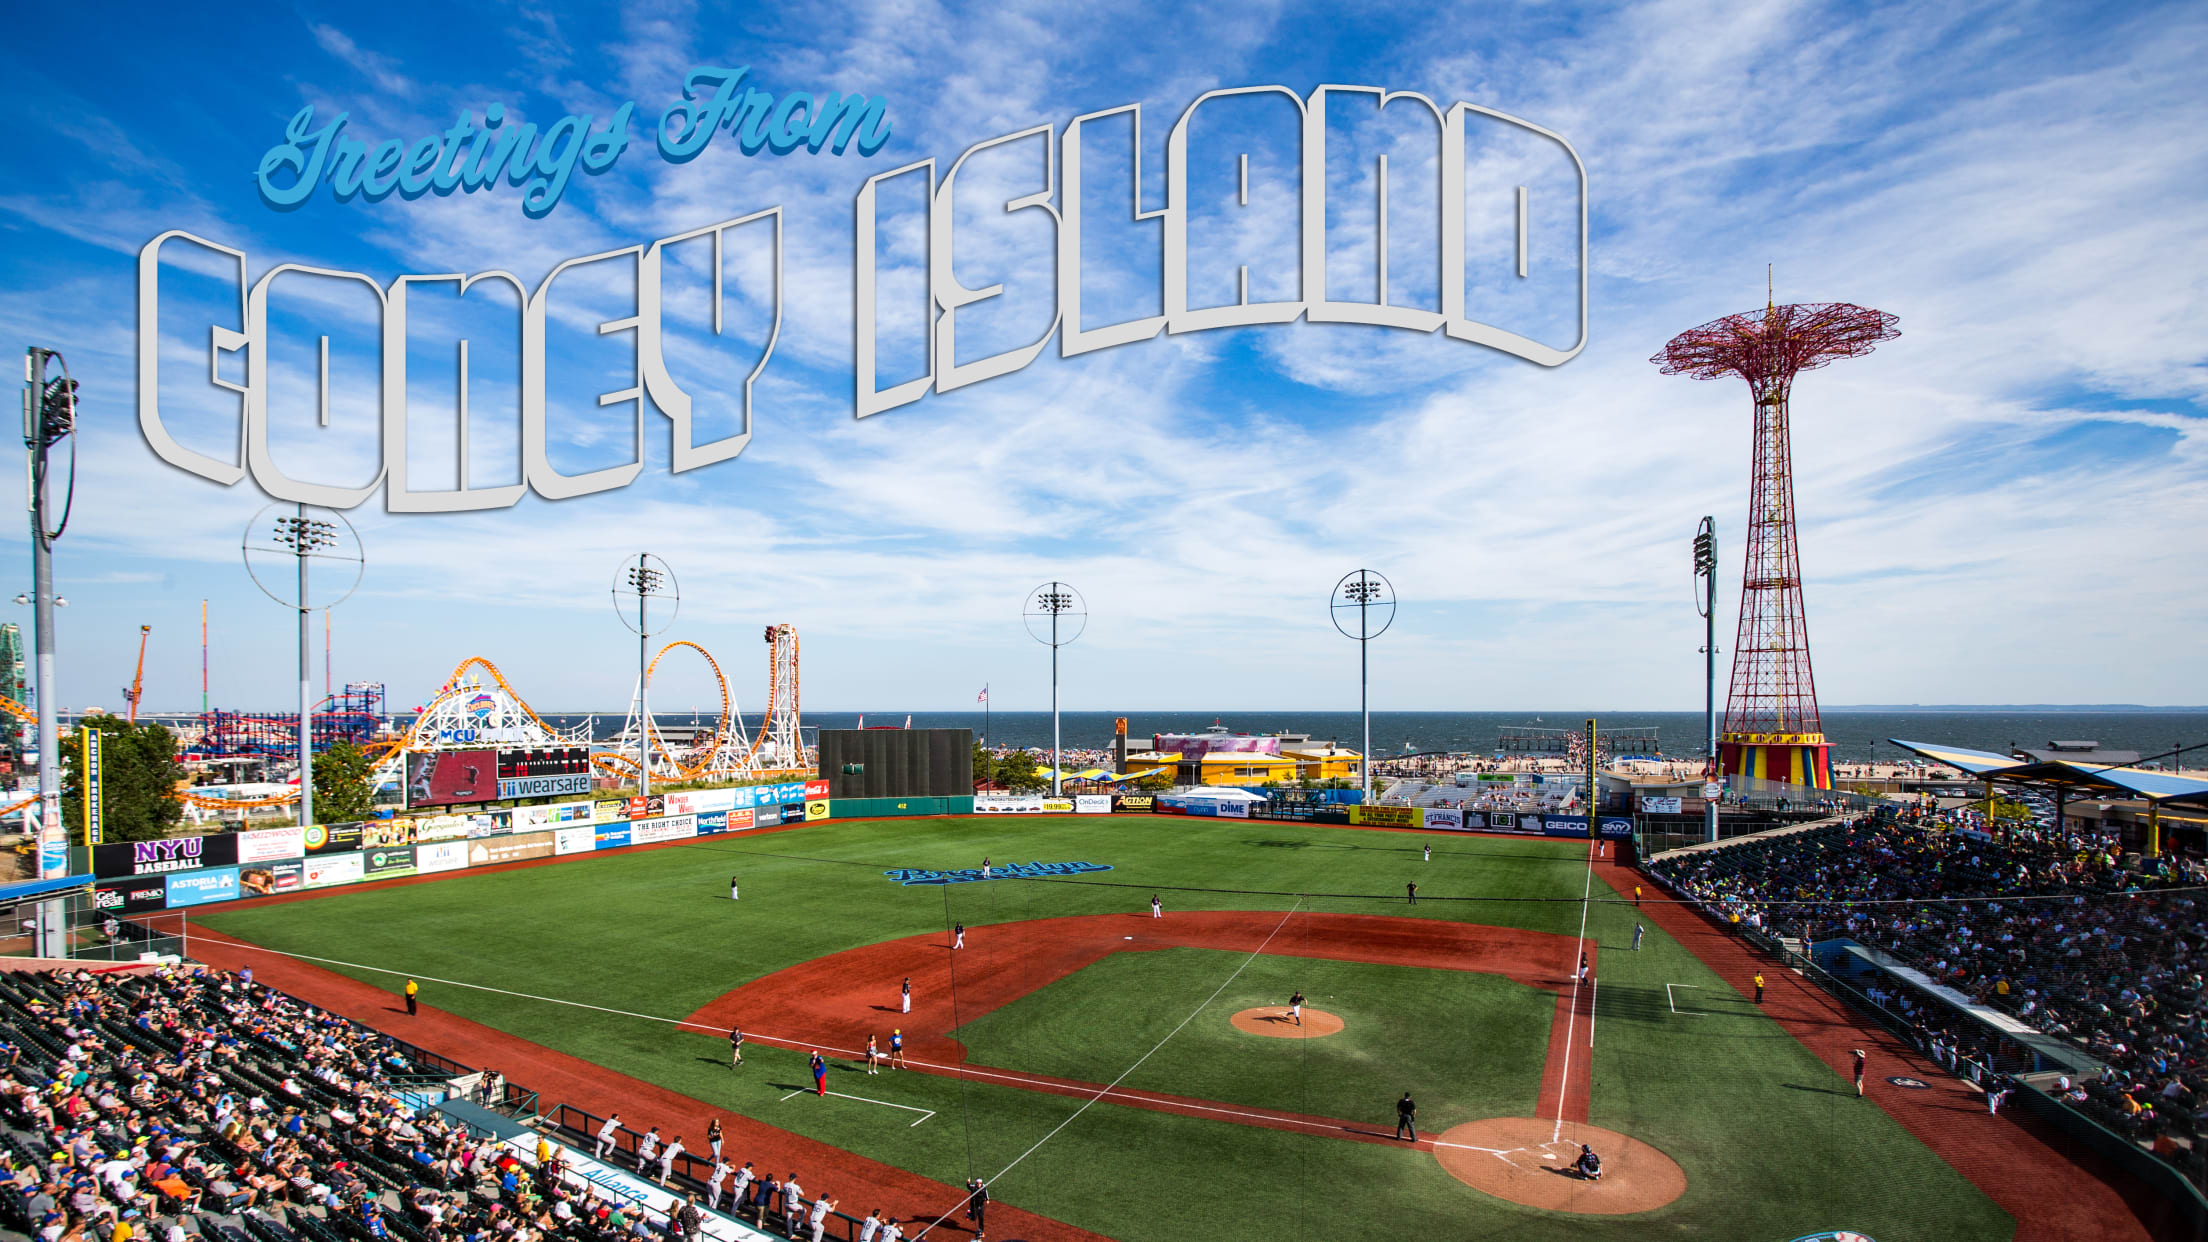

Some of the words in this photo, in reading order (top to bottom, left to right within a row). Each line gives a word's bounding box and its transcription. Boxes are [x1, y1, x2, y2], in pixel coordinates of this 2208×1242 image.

[440, 729, 475, 742] MCU
[518, 776, 588, 795] wearsafe
[1078, 798, 1105, 806] OnDeck
[1115, 795, 1153, 807] ACTION
[637, 822, 650, 831] THE
[651, 820, 670, 829] RIGHT
[671, 818, 693, 827] CHOICE
[697, 813, 727, 825] Northfield
[1493, 814, 1513, 825] TGI
[1545, 820, 1588, 831] GEICO
[1601, 822, 1626, 832] SNY
[250, 828, 301, 840] MIDWOOD
[133, 836, 204, 863] NYU
[133, 857, 204, 875] BASEBALL
[171, 876, 218, 890] ASTORIA
[95, 890, 118, 901] Get
